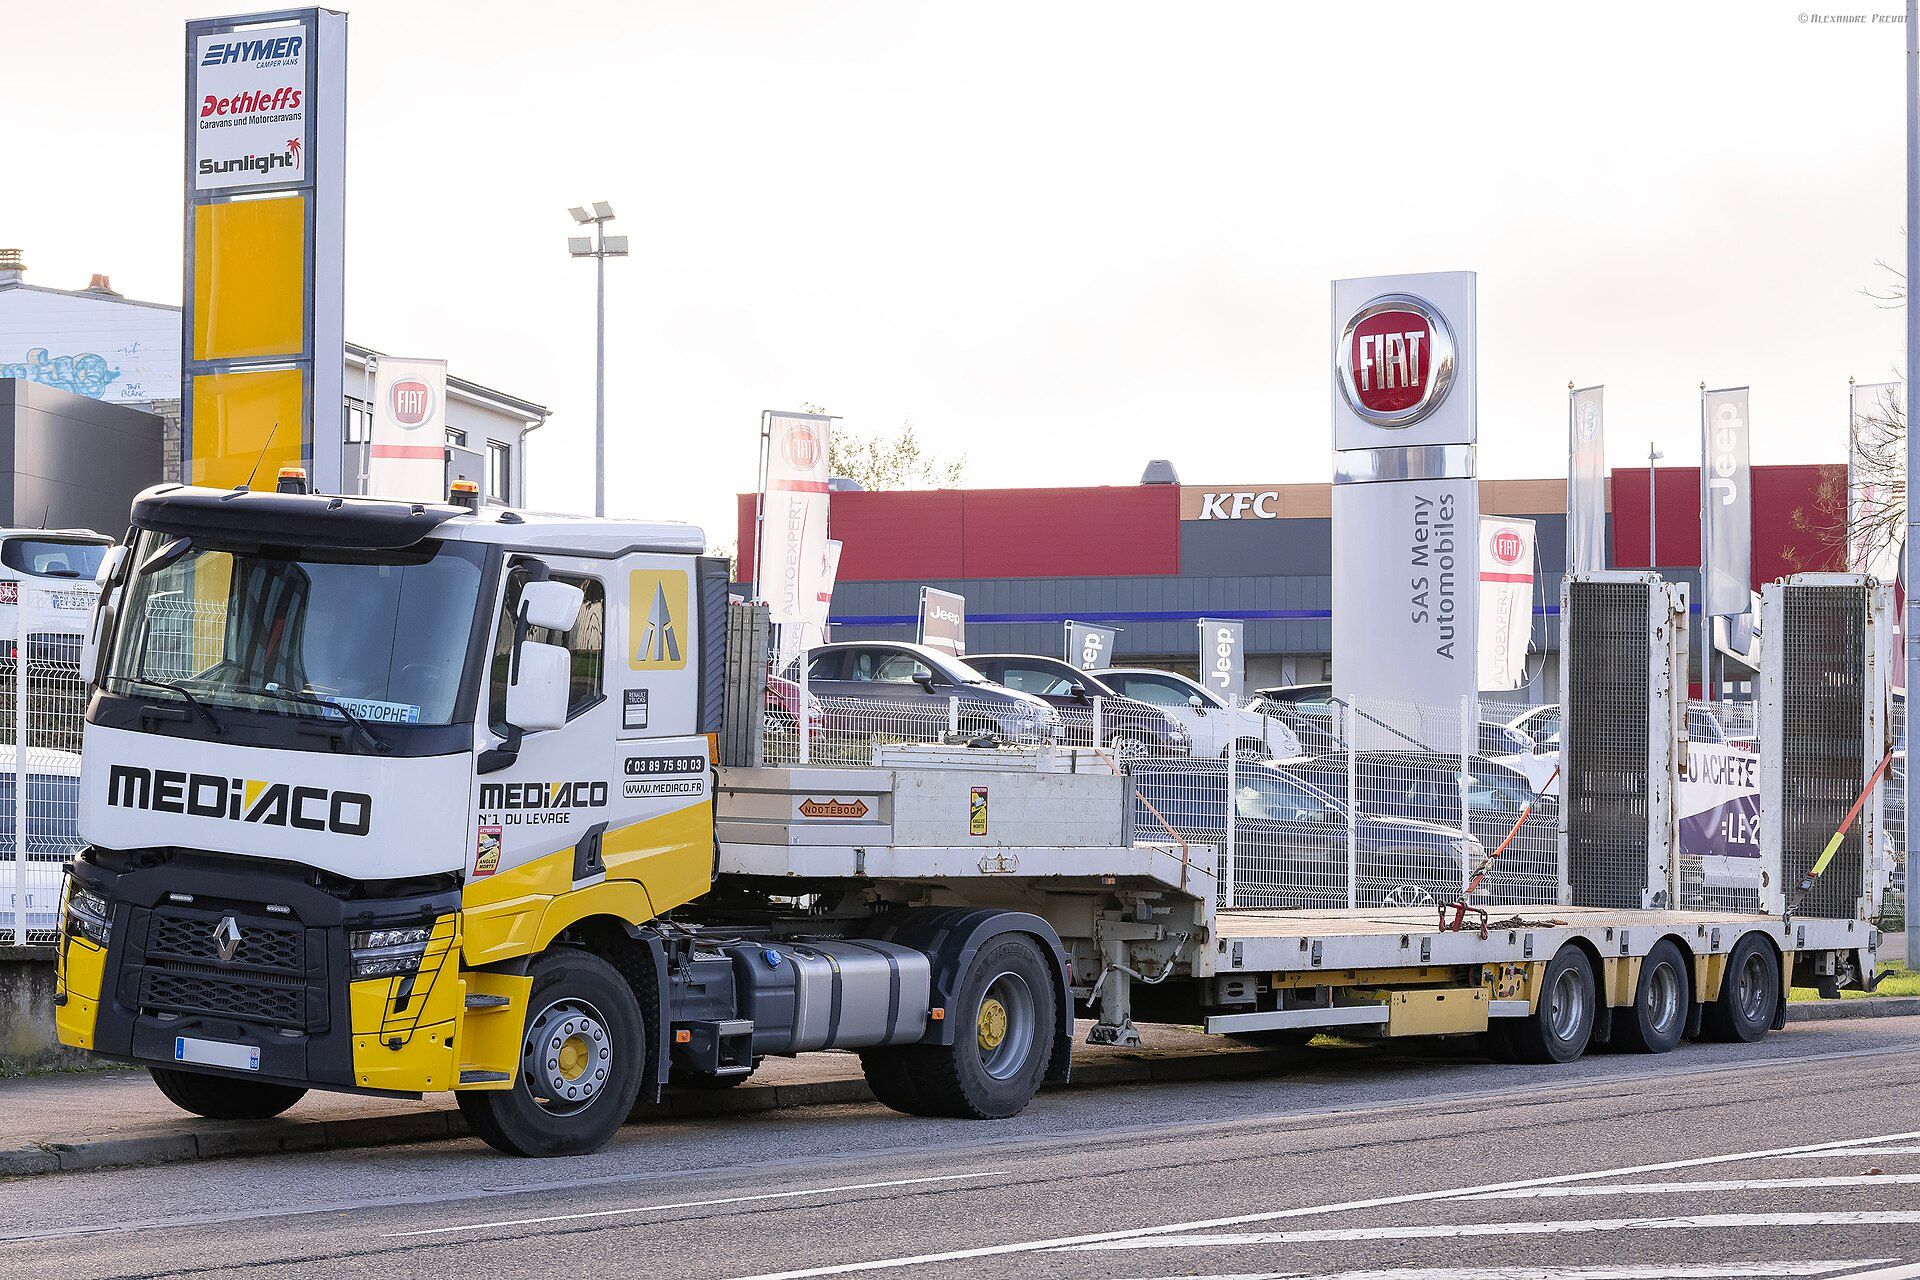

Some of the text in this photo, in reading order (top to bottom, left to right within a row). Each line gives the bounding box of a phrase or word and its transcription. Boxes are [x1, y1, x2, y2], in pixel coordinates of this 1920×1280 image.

[222, 36, 302, 64] HYMER
[256, 60, 282, 68] CAMPER
[200, 86, 302, 117] Dethleffs
[200, 112, 302, 130] Caravans und Motorcaravans
[200, 152, 293, 174] Sunlight
[1360, 330, 1426, 391] FIAT
[398, 390, 424, 414] FIAT
[792, 439, 814, 459] FIAT
[1710, 402, 1742, 506] Jeep
[1198, 491, 1278, 520] KFC
[783, 496, 802, 616] AUTOEXPERT
[1412, 495, 1434, 624] SAS Meny
[1499, 538, 1518, 556] FIAT
[1434, 494, 1454, 660] Automobiles
[930, 605, 961, 626] Jeep
[1494, 588, 1508, 685] AUTOEXPERT
[1082, 632, 1103, 670] eep
[1212, 627, 1235, 688] Jeep
[333, 702, 408, 721] CHRISTOPHE
[634, 759, 701, 772] 03 89 75 90 03
[1702, 754, 1757, 788] ACHETE
[626, 783, 702, 793] WWW.MEDIACO.FR
[478, 812, 570, 825] N°1 DU LEVAGE
[804, 806, 863, 814] NOOTEBOOM
